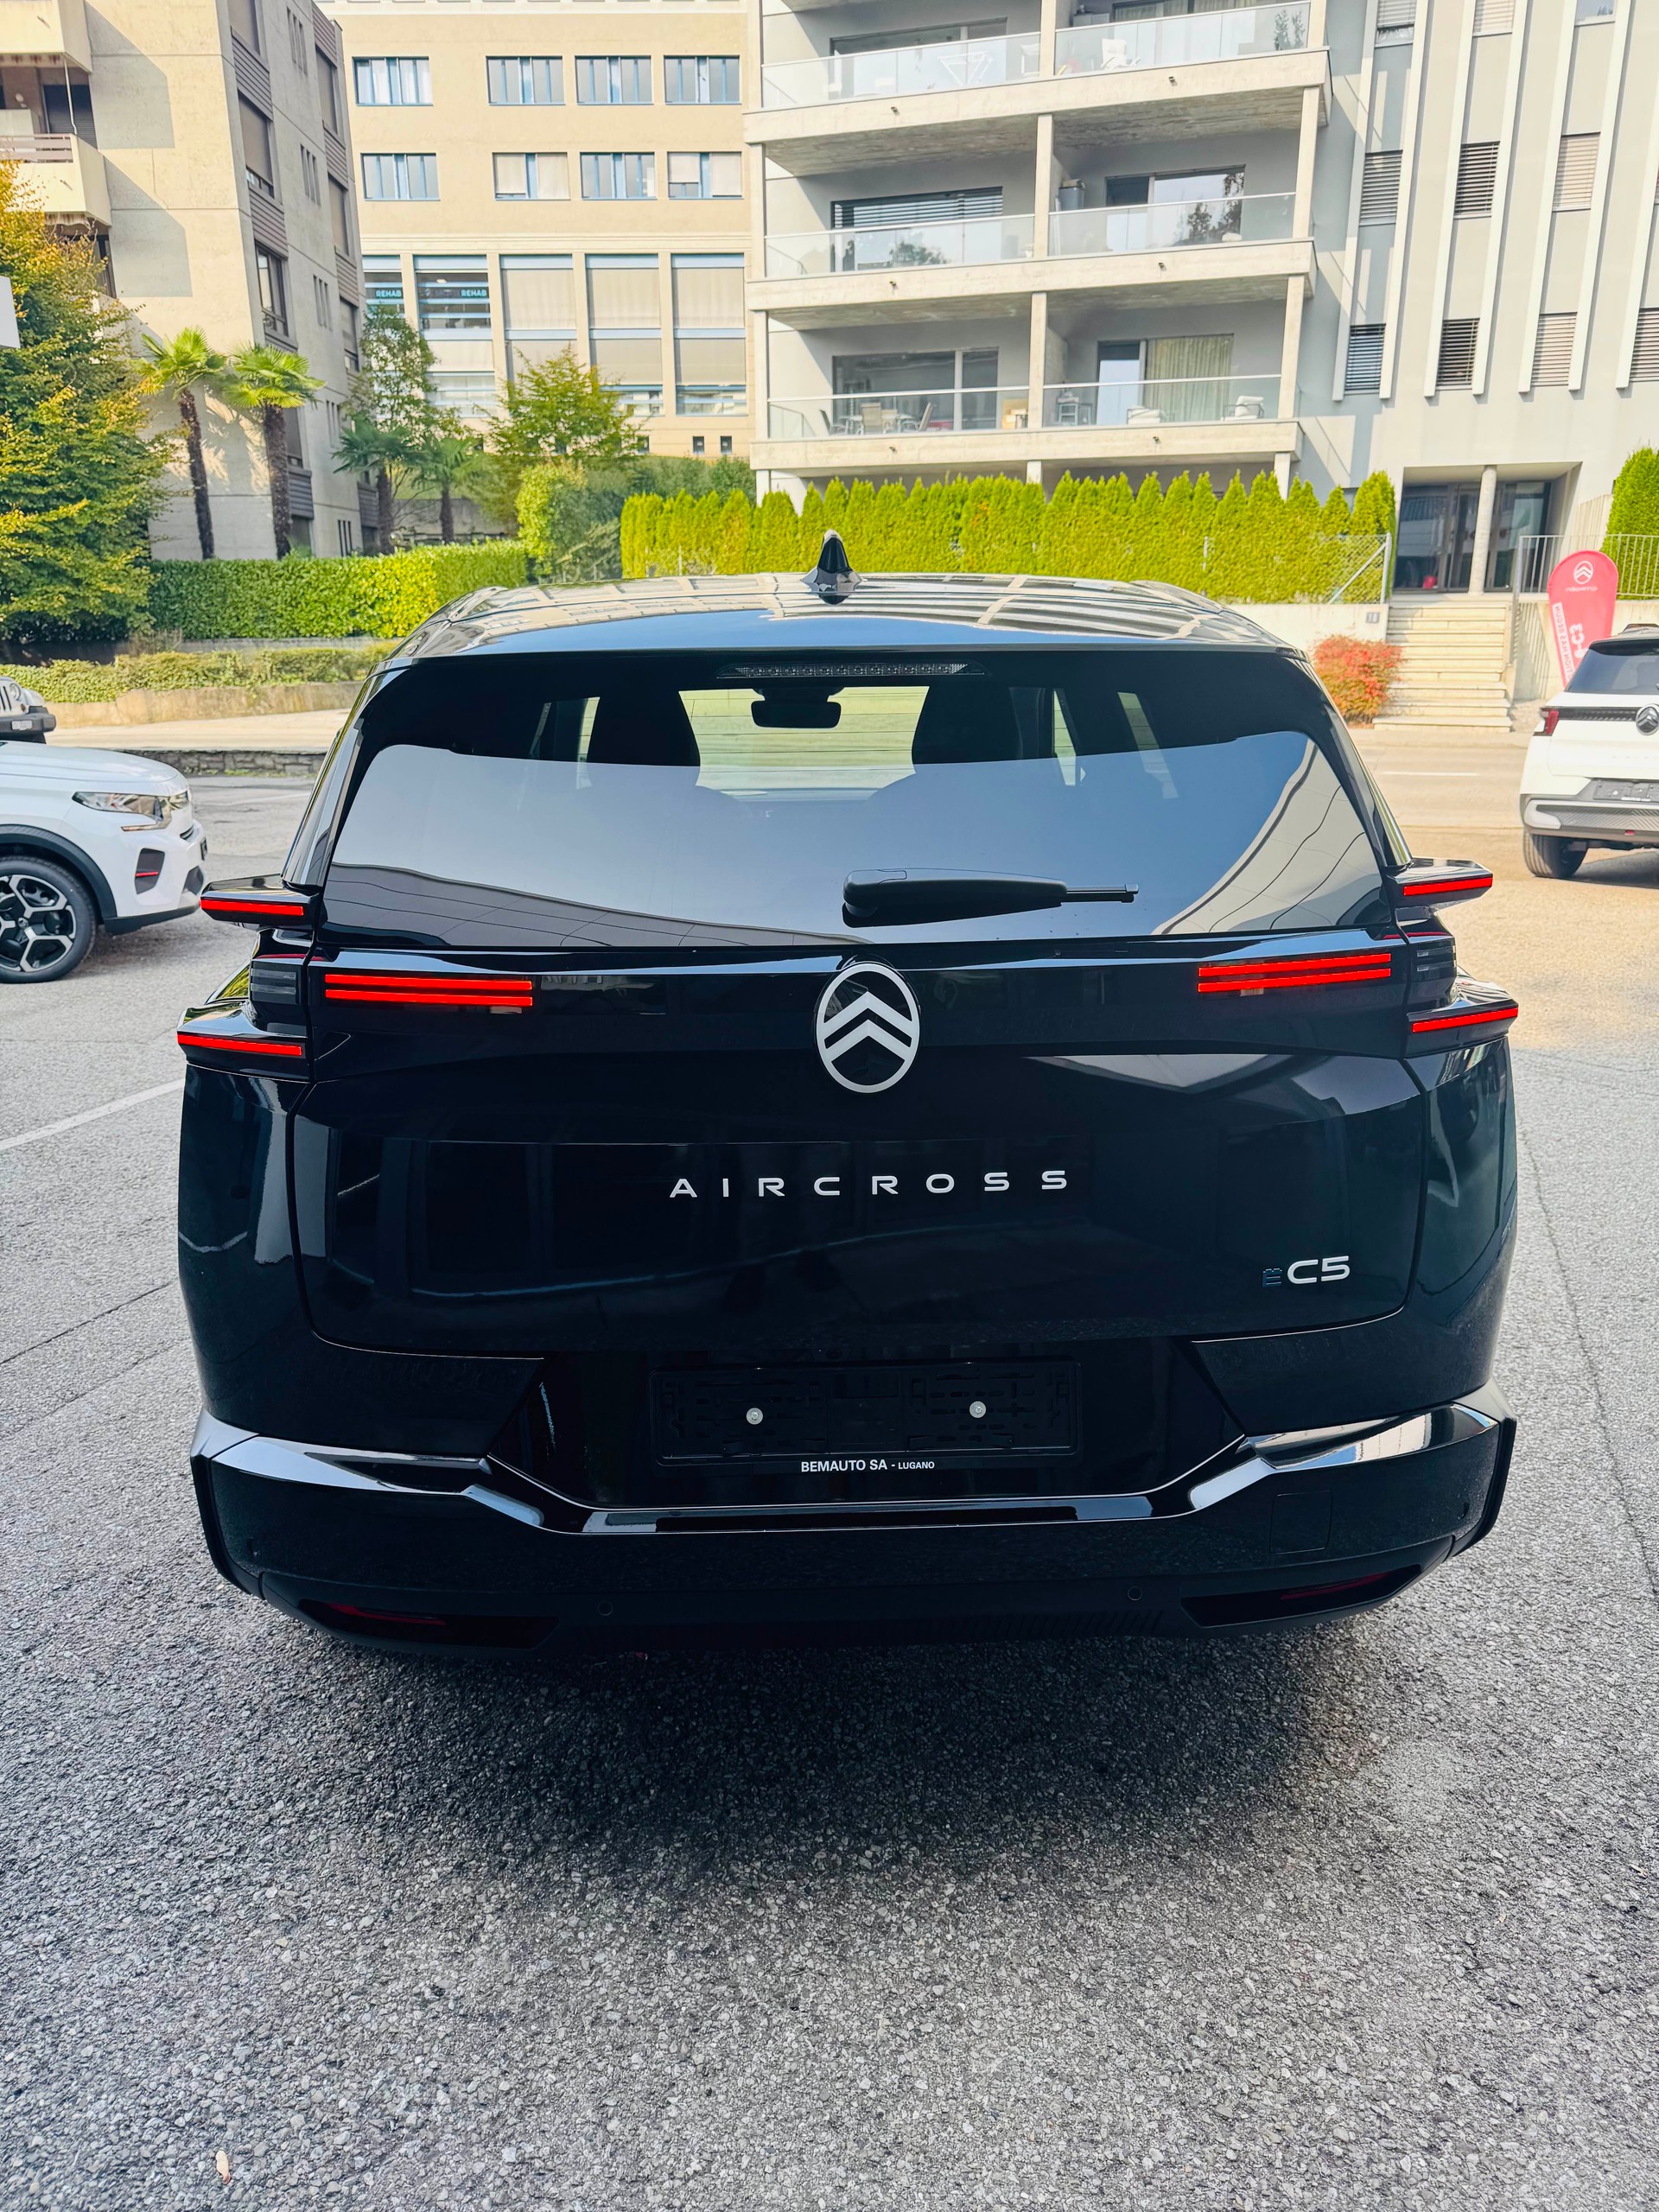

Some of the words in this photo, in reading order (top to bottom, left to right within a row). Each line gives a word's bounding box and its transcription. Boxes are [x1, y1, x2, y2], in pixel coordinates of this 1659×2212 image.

[376, 289, 402, 298] REHAB
[670, 1170, 1067, 1198] AIRCROSS
[801, 1459, 866, 1472] BEMAUTO
[869, 1459, 887, 1471] SA
[898, 1461, 935, 1470] LUGANO
